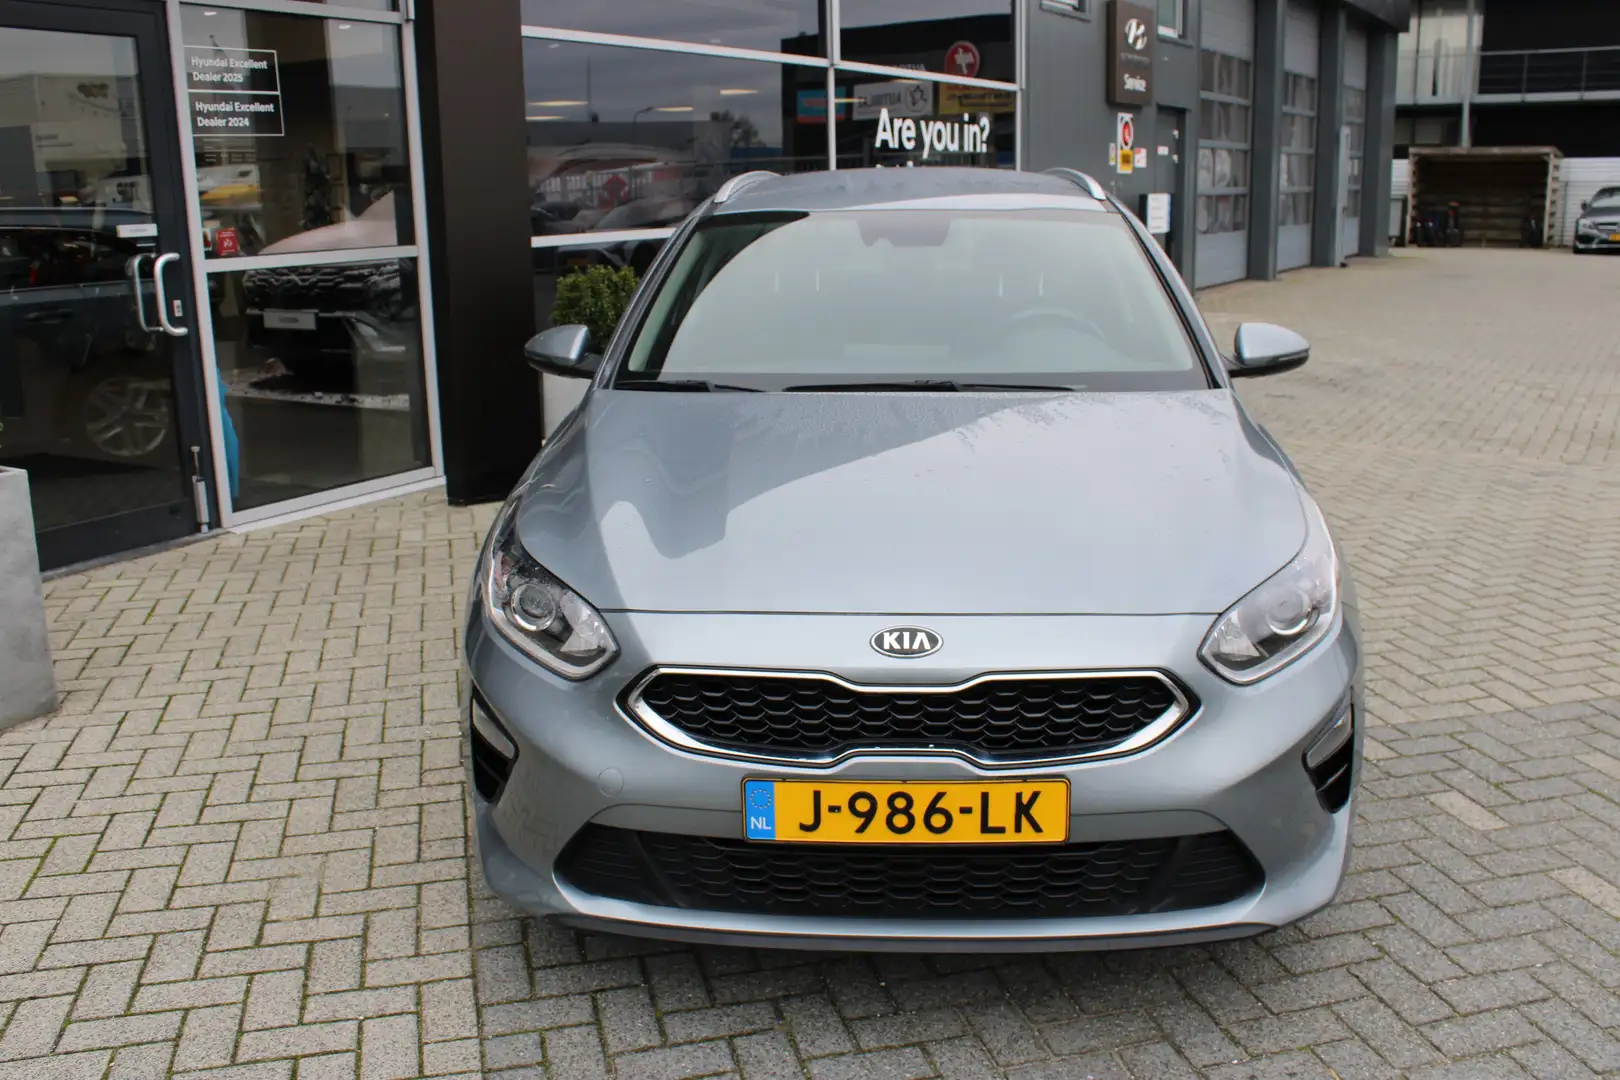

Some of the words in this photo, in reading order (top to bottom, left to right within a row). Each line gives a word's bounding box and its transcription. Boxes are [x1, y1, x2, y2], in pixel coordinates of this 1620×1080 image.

[191, 56, 228, 69] Hyundai
[229, 58, 268, 69] Excellent
[193, 71, 221, 81] Dealer
[222, 73, 244, 83] 2025
[1124, 73, 1147, 92] Service
[195, 101, 233, 113] Hyundai
[234, 102, 274, 112] Excellent
[197, 116, 226, 127] Dealer
[227, 117, 250, 127] 2024
[874, 107, 916, 150] Are
[919, 118, 959, 159] you
[963, 112, 990, 153] in?
[882, 631, 931, 650] KIA
[750, 815, 772, 830] NL
[799, 789, 1044, 835] J-986-LK
